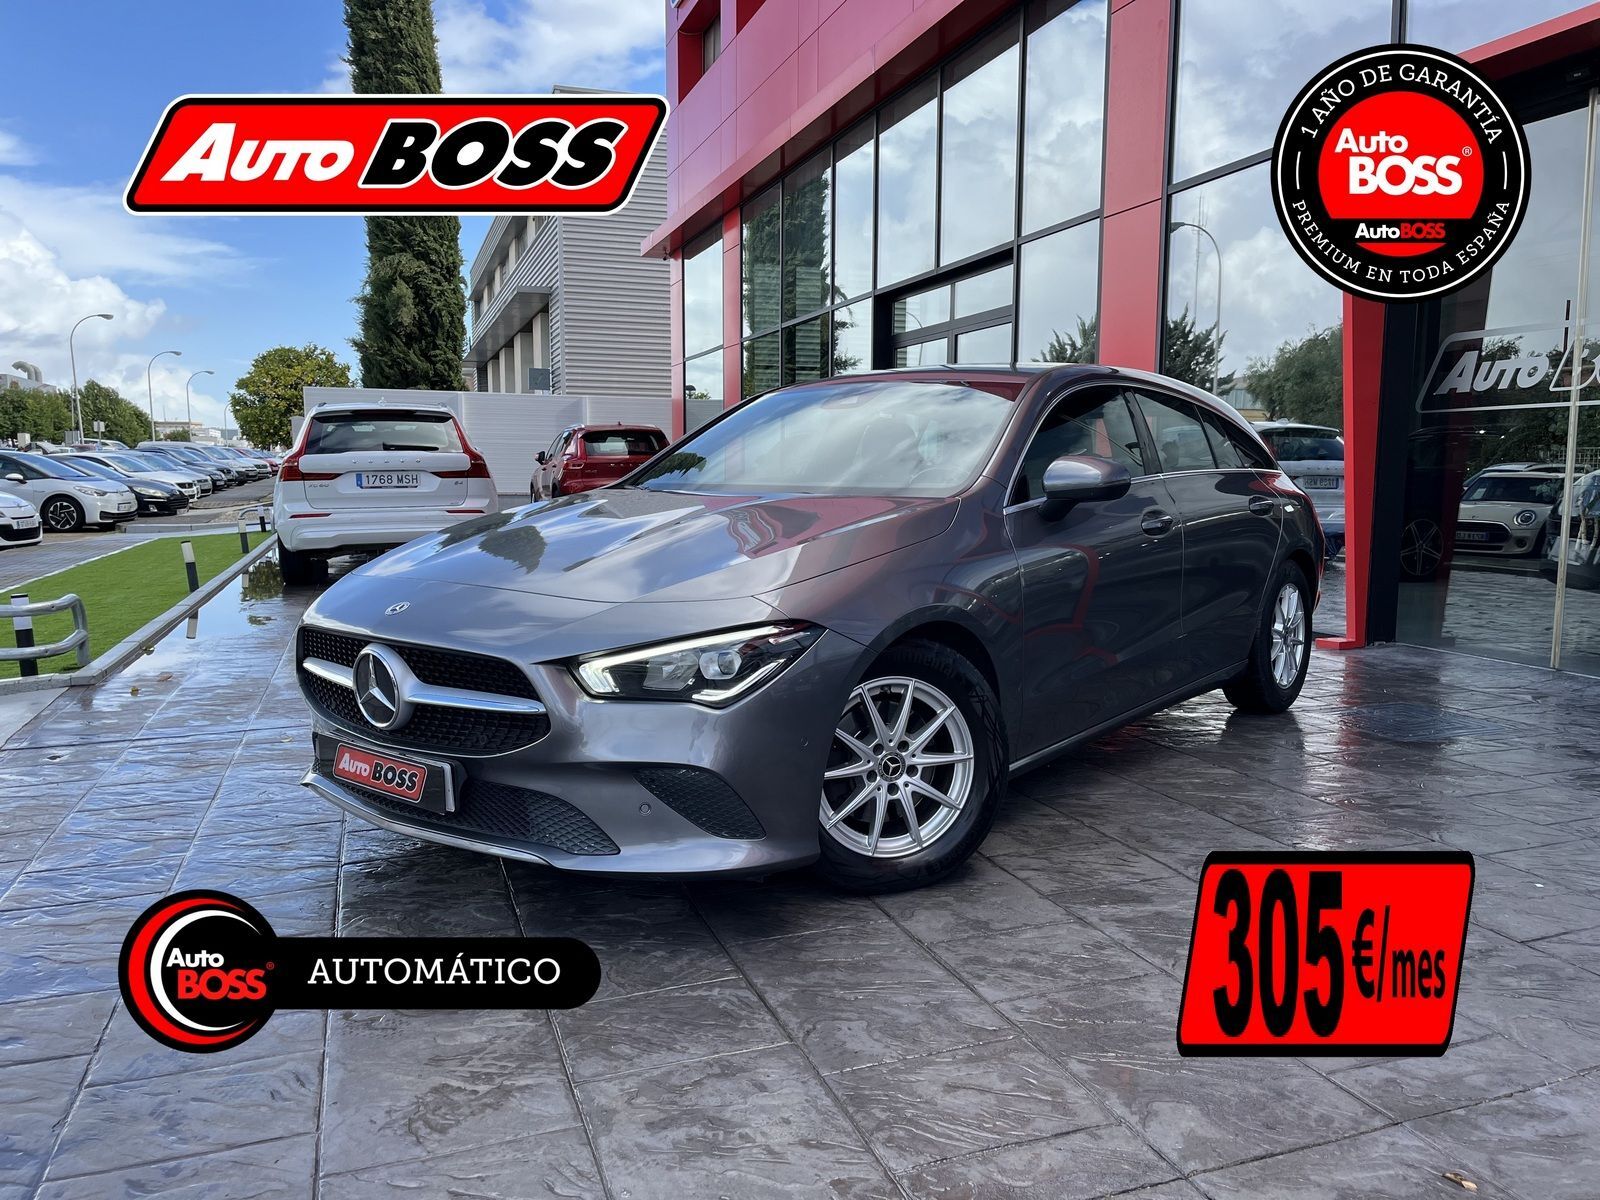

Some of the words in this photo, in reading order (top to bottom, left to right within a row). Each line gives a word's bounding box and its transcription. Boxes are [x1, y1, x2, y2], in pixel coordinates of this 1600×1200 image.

[365, 474, 393, 485] 1768
[396, 474, 419, 484] MSH
[371, 760, 419, 793] BOSS
